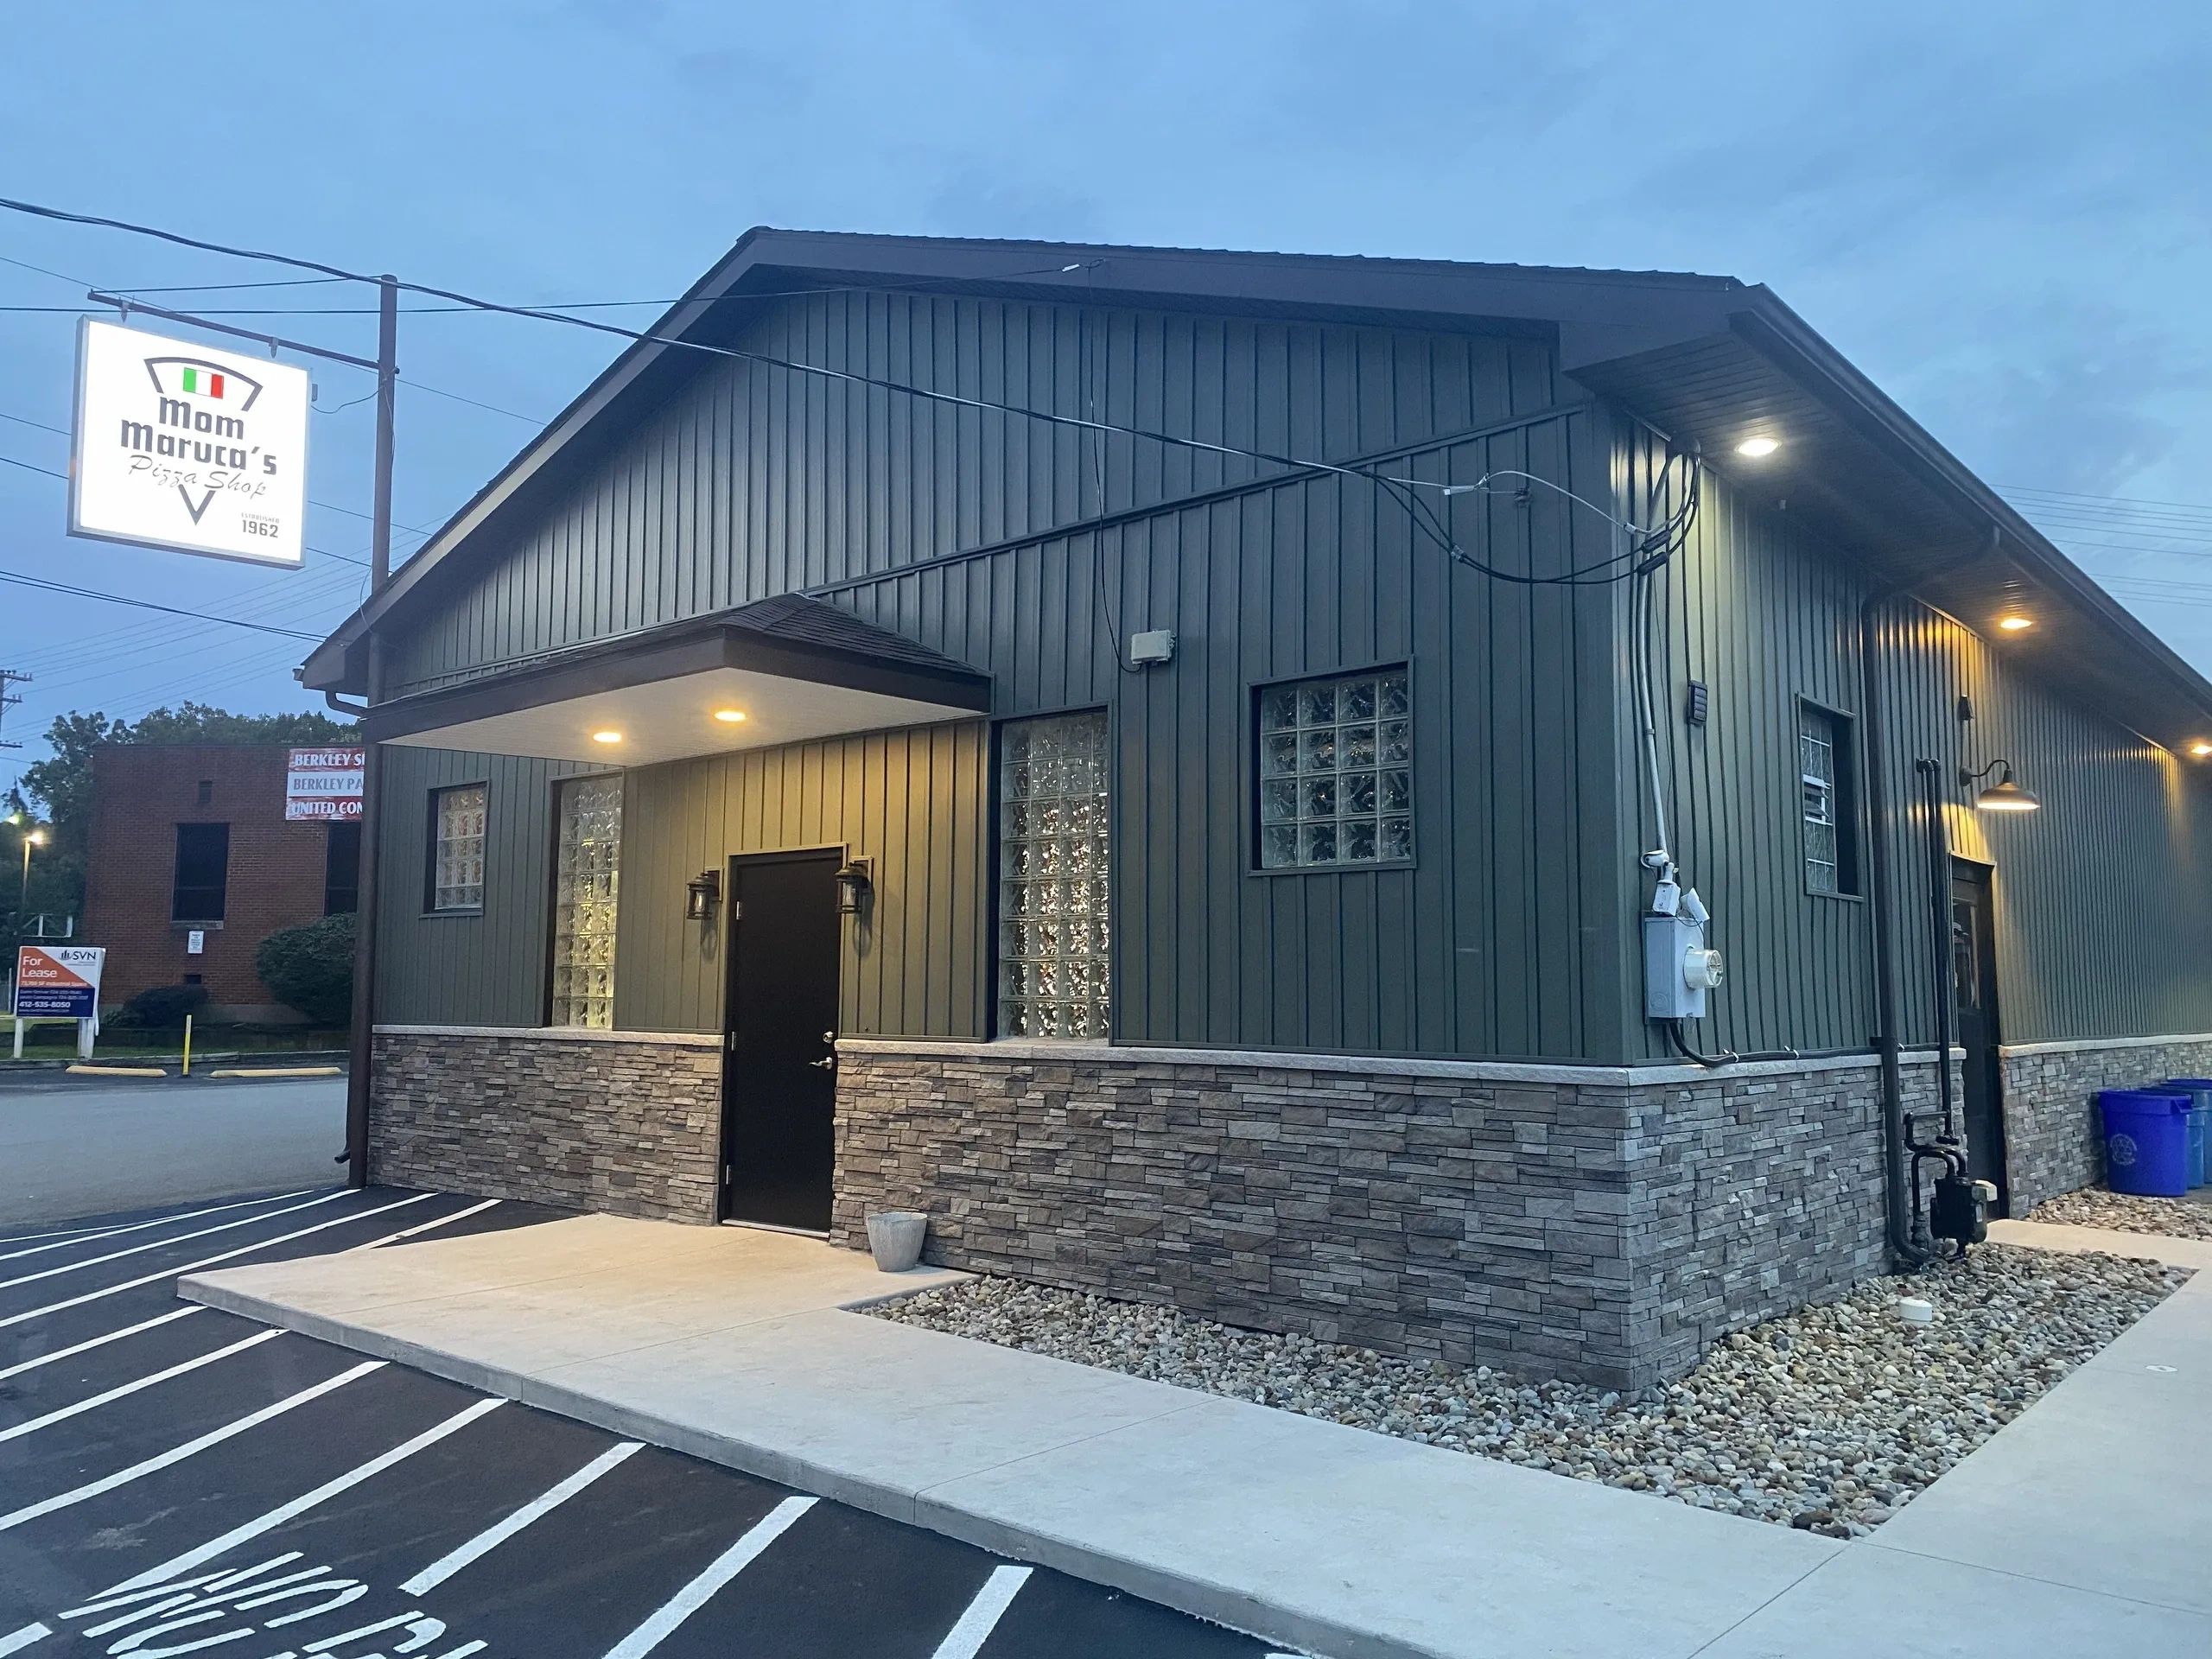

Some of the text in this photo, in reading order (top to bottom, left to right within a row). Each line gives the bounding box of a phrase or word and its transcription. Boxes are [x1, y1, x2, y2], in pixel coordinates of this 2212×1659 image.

[129, 454, 266, 499] Pizza Shop
[242, 519, 278, 538] 1962
[295, 753, 365, 766] BERKLEY S
[294, 779, 344, 790] BERKLEY
[291, 802, 336, 814] UNITED
[73, 950, 96, 960] SVN
[22, 957, 42, 966] For
[22, 969, 57, 978] Lease
